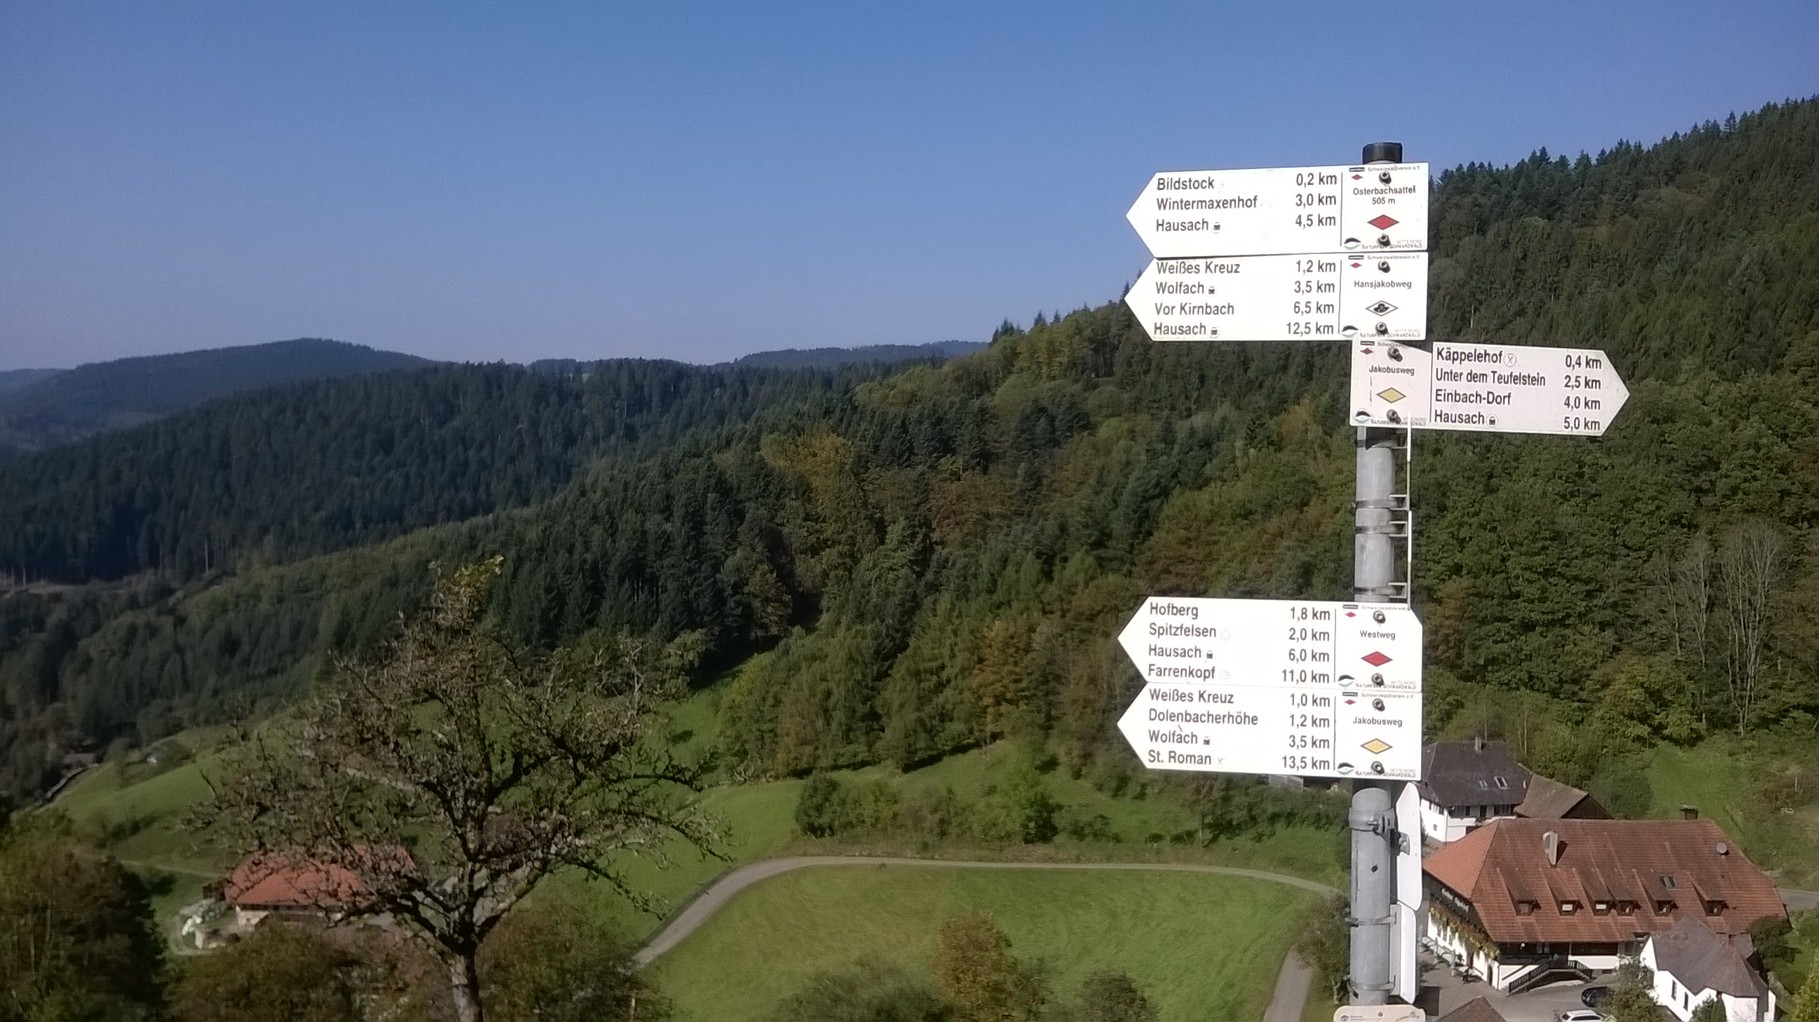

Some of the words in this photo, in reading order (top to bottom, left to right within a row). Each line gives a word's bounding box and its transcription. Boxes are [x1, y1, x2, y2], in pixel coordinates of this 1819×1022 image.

[1157, 176, 1215, 190] Bildstock
[1296, 172, 1314, 188] 0,2
[1318, 172, 1338, 185] km
[1353, 185, 1416, 196] Osterbachsattel
[1156, 195, 1258, 210] Wintermaxenhof
[1295, 194, 1314, 208] 3,0
[1318, 193, 1336, 206] km
[1372, 197, 1386, 205] 505
[1156, 218, 1209, 232] Hausach
[1295, 214, 1314, 230] 4,5
[1318, 214, 1336, 226] km
[1156, 261, 1200, 274] Weißes
[1204, 261, 1240, 274] Kreuz
[1296, 260, 1314, 274] 1,2
[1318, 260, 1336, 272] km
[1156, 282, 1204, 294] Wolfach
[1294, 280, 1312, 295] 3,5
[1316, 280, 1335, 293] km
[1354, 280, 1412, 290] Hansjakobweg
[1155, 302, 1176, 315] Vor
[1180, 302, 1234, 315] Kirnbach
[1294, 301, 1312, 316] 6,5
[1316, 301, 1334, 314] km
[1154, 322, 1206, 335] Hausach
[1286, 322, 1311, 337] 12,5
[1316, 322, 1334, 334] km
[1436, 347, 1502, 364] Käppelehof
[1565, 354, 1582, 370] 0,4
[1586, 356, 1602, 369] km
[1369, 365, 1415, 376] Jakobusweg
[1436, 368, 1464, 382] Unter
[1466, 369, 1488, 383] dem
[1491, 370, 1546, 386] Teufelstein
[1564, 374, 1581, 390] 2,5
[1584, 376, 1601, 390] km
[1435, 388, 1511, 406] Einbach-Dorf
[1564, 396, 1580, 411] 4,0
[1584, 396, 1600, 410] km
[1434, 410, 1485, 424] Hausach
[1564, 416, 1580, 431] 5,0
[1584, 418, 1600, 430] km
[1150, 602, 1198, 620] Hofberg
[1290, 607, 1308, 622] 1,8
[1312, 607, 1330, 620] km
[1149, 622, 1216, 638] Spitzfelsen
[1288, 628, 1307, 642] 2,0
[1312, 628, 1330, 641] km
[1360, 630, 1396, 640] Westweg
[1148, 644, 1202, 658] Hausach
[1288, 648, 1306, 664] 6,0
[1311, 649, 1330, 662] km
[1148, 664, 1216, 682] Farrenkopf
[1282, 669, 1306, 684] 11,0
[1311, 670, 1330, 684] km
[1149, 688, 1194, 702] Weißes
[1198, 690, 1234, 704] Kreuz
[1290, 693, 1308, 708] 1,0
[1312, 694, 1330, 707] km
[1148, 708, 1258, 725] Dolenbacherhöhe
[1290, 714, 1307, 728] 1,2
[1312, 715, 1330, 728] km
[1353, 716, 1402, 728] Jakobusweg
[1148, 730, 1198, 744] Wolfach
[1288, 735, 1307, 750] 3,5
[1311, 736, 1330, 749] km
[1148, 749, 1164, 763] St.
[1168, 750, 1212, 765] Roman
[1282, 756, 1306, 771] 13,5
[1312, 756, 1330, 770] km
